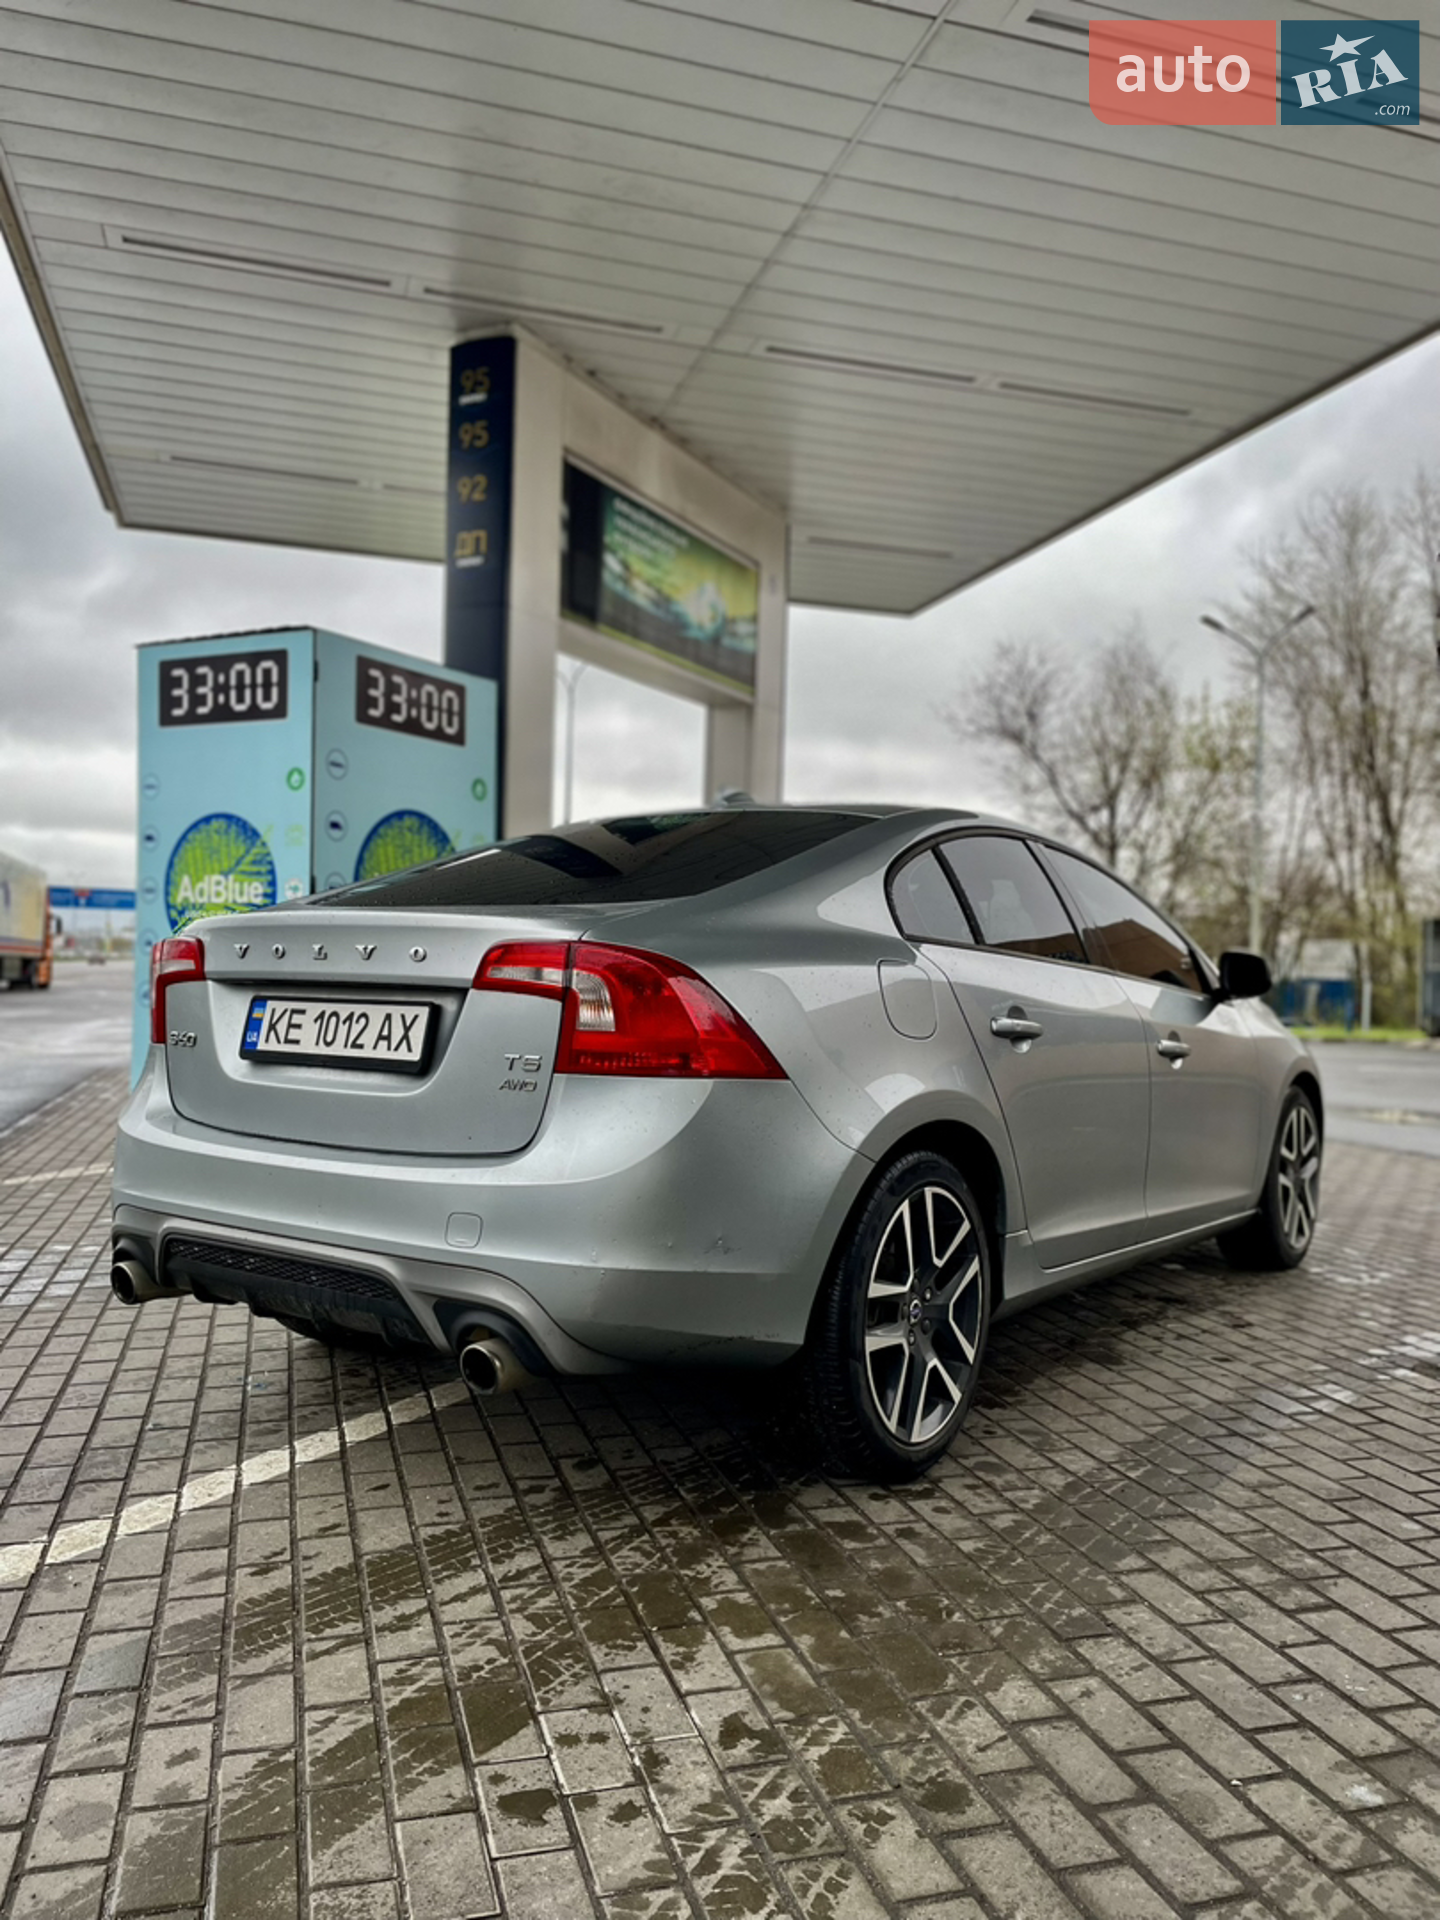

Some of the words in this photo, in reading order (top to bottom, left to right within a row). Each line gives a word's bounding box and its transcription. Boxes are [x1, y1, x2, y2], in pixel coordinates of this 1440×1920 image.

[460, 367, 490, 394] 95
[459, 420, 489, 449] 95
[457, 474, 488, 504] 92
[170, 660, 279, 717] 33:00
[367, 668, 460, 735] 33:00
[176, 873, 264, 905] AdBlue
[234, 943, 427, 962] VOLVO
[264, 1007, 306, 1045] KE
[313, 1009, 370, 1049] 1012
[372, 1012, 420, 1053] AX
